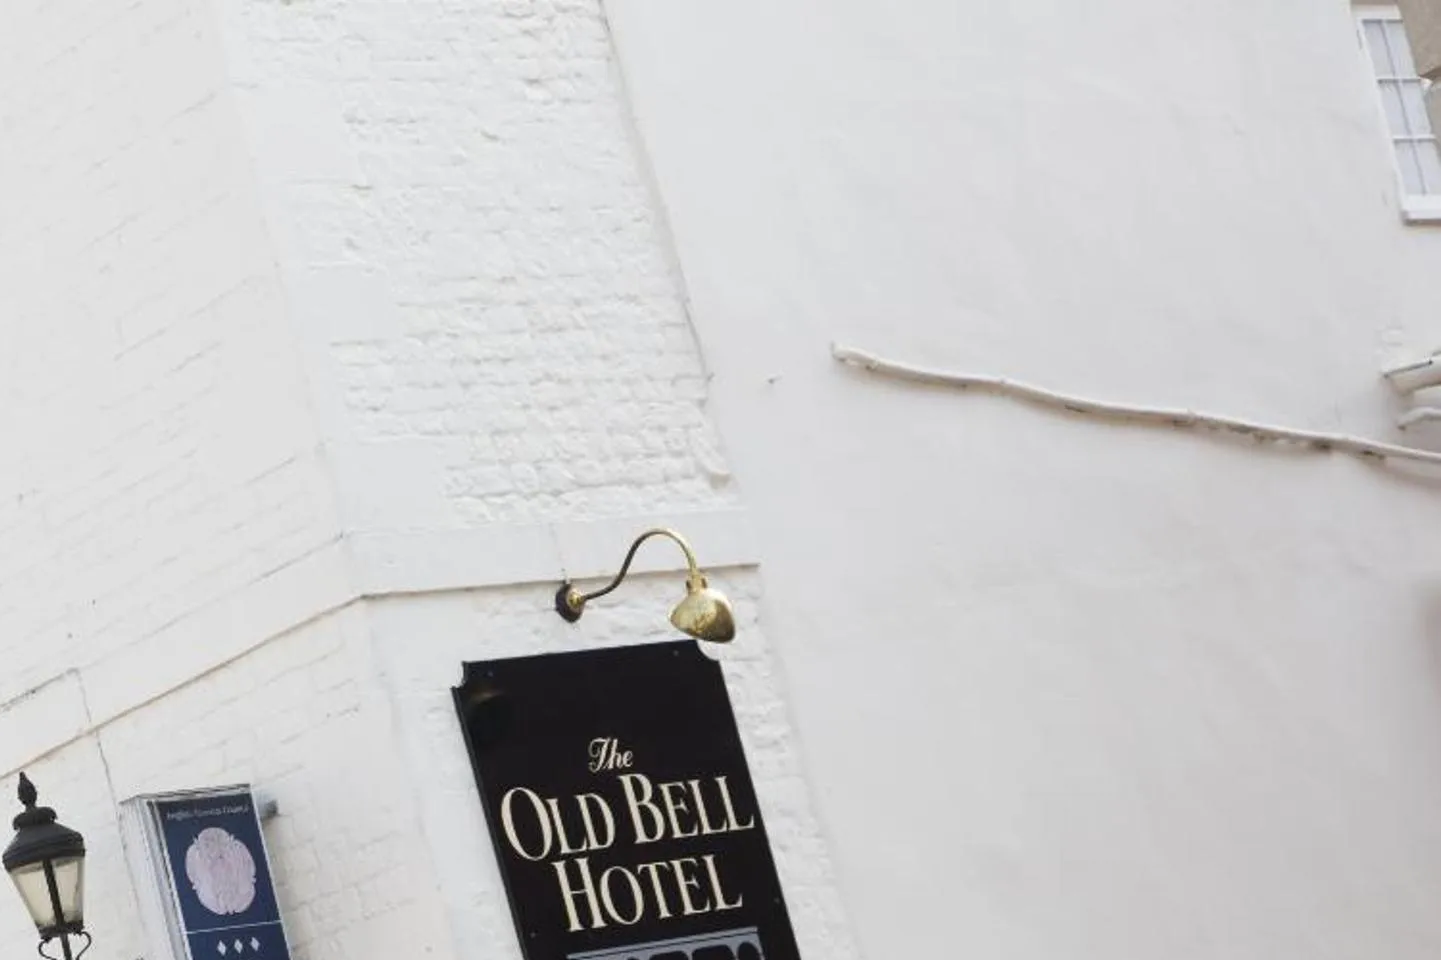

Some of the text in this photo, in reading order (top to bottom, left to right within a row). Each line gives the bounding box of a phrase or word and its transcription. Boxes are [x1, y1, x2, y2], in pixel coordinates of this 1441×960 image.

[589, 737, 633, 772] The
[501, 773, 754, 861] OLD BELL
[552, 855, 742, 932] HOTEL
